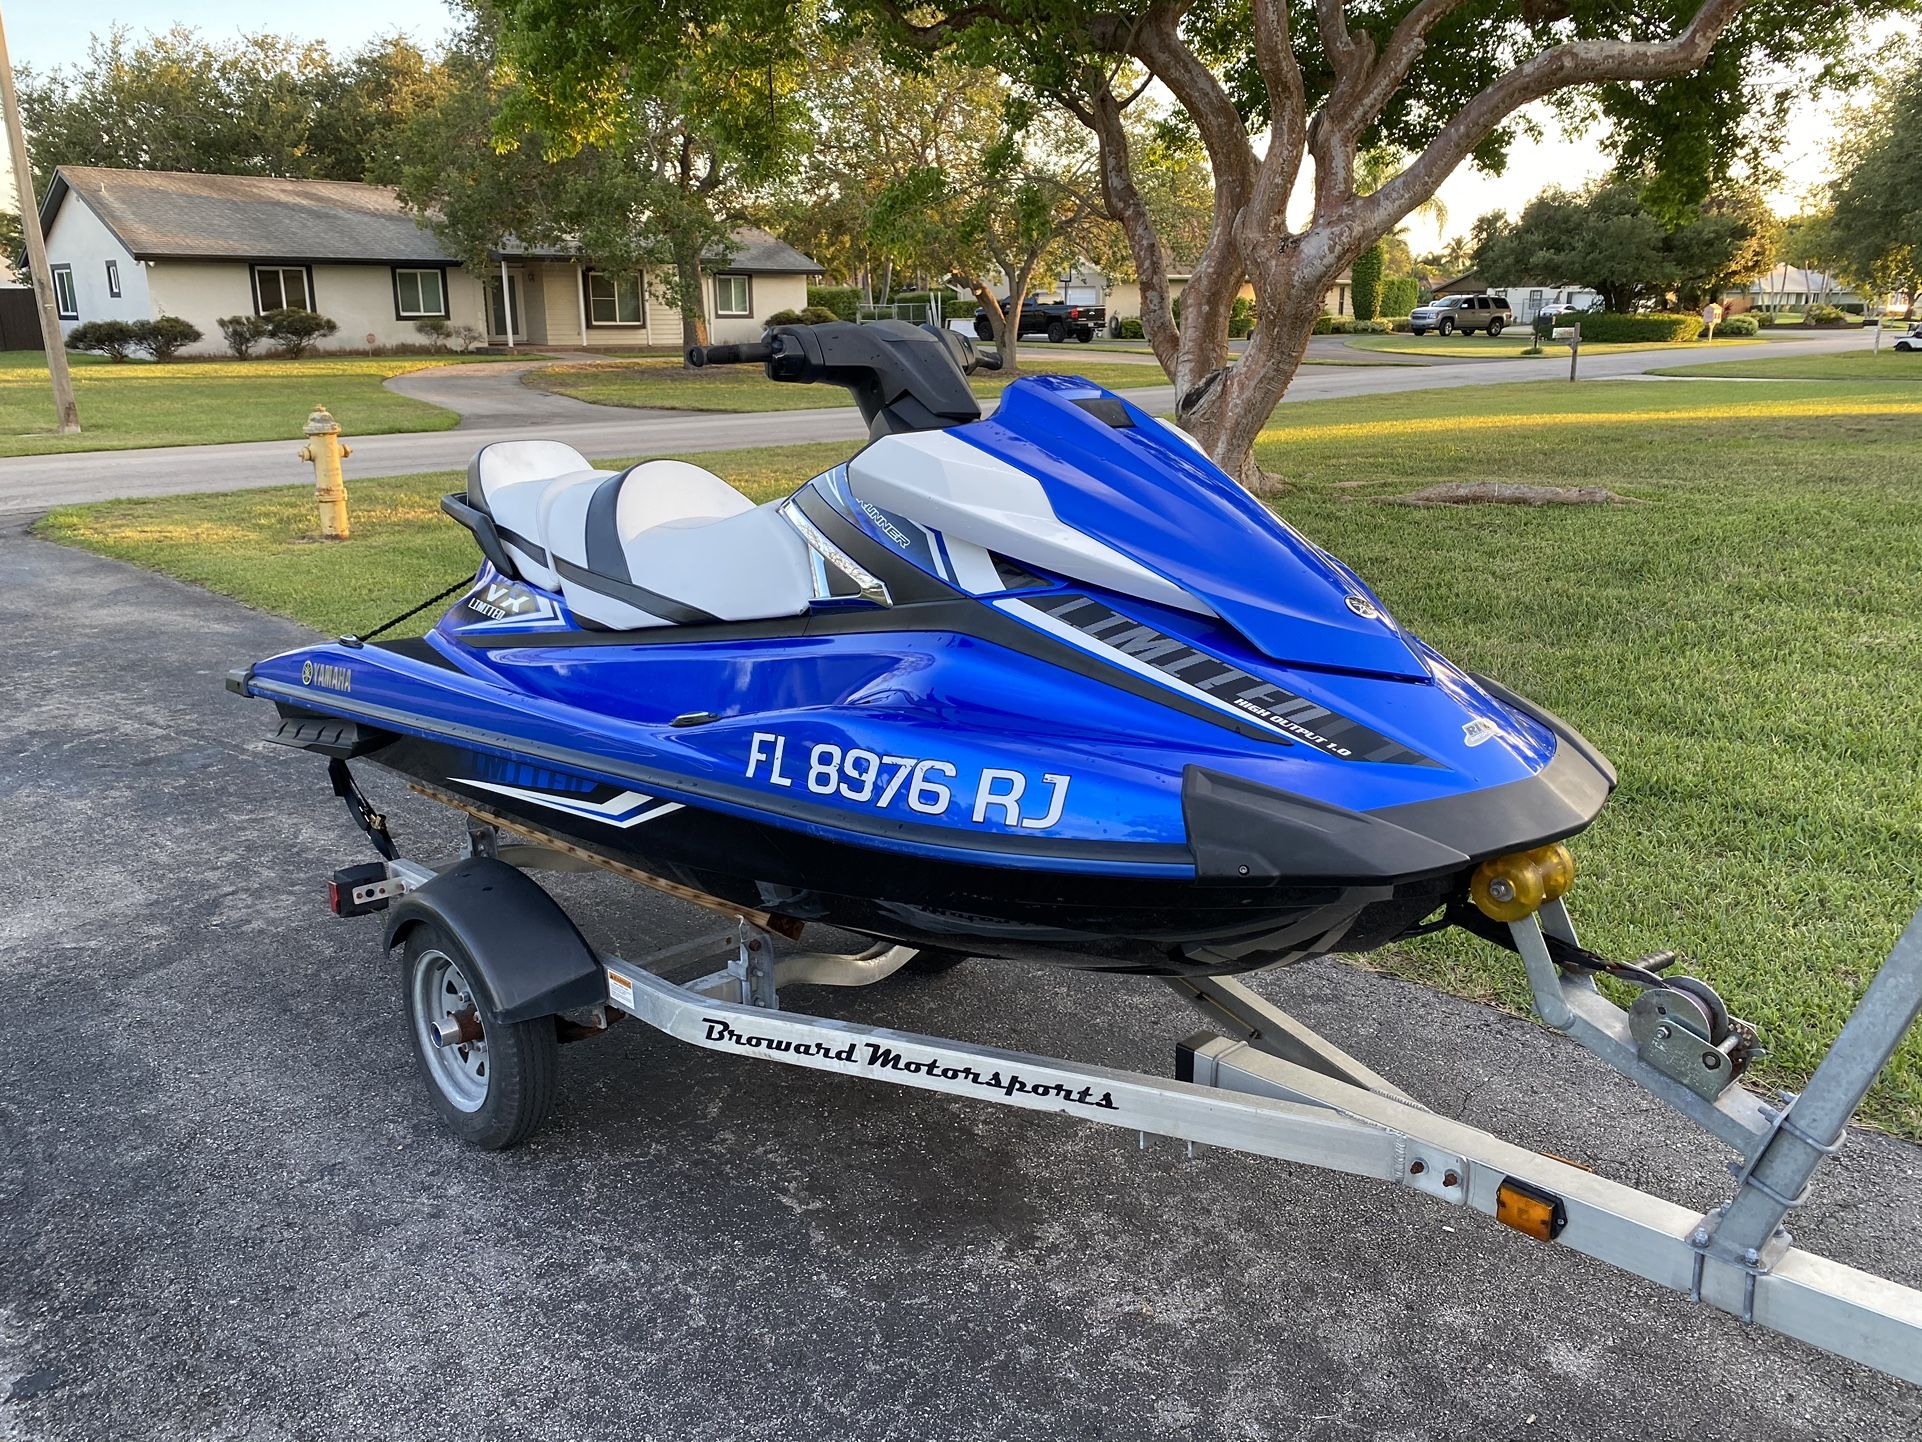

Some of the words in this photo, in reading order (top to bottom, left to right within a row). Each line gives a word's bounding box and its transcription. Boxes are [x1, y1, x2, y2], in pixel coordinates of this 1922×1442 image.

[467, 597, 506, 621] LIMITED
[486, 583, 530, 613] VX
[313, 662, 352, 693] YAMAHA
[1233, 697, 1268, 718] HIGH
[1269, 713, 1329, 744] OUTPUT
[1325, 740, 1352, 757] 1.0
[745, 731, 792, 787] FL
[807, 743, 957, 815] 8976
[971, 767, 1071, 829] RJ
[701, 1017, 859, 1063] Broward
[864, 1042, 1120, 1110] Motorsports
